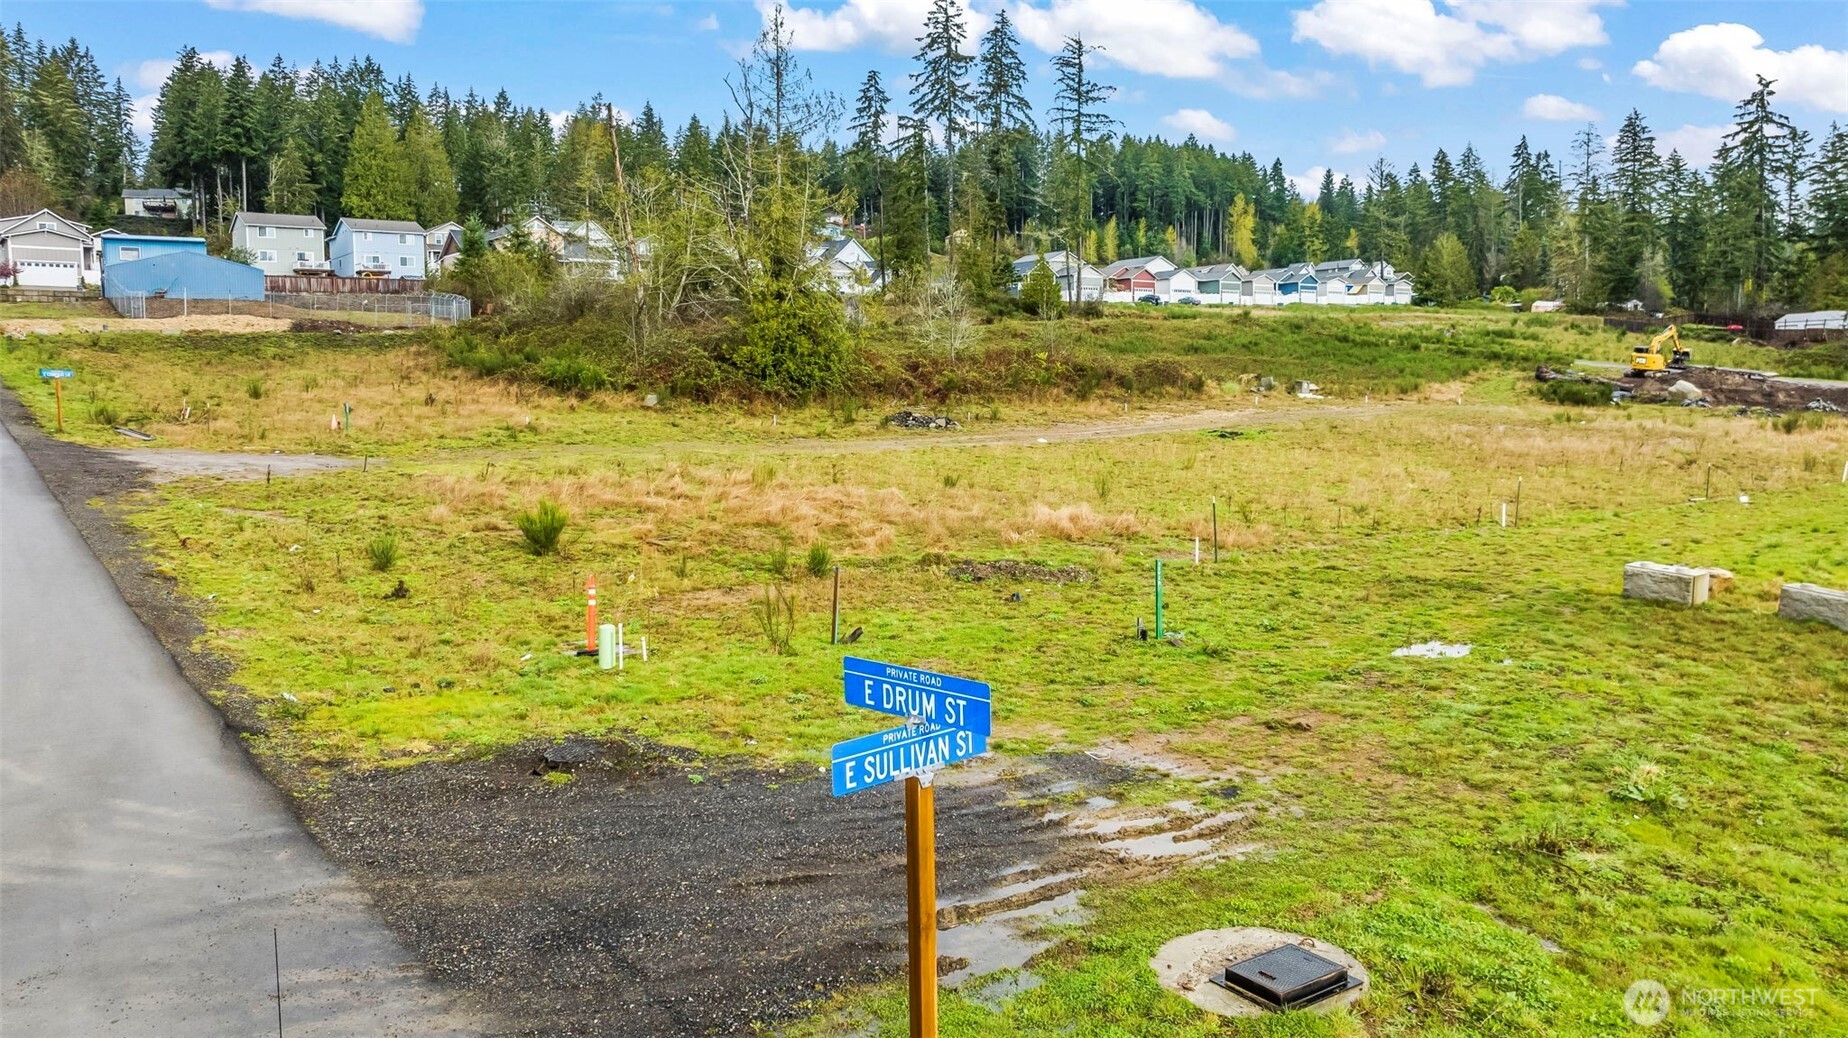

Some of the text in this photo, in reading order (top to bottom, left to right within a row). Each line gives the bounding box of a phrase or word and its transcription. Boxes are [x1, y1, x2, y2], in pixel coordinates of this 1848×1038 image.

[886, 667, 942, 687] PRIVATE ROAD
[864, 680, 967, 726] E DRUM ST
[882, 727, 917, 745] PRIVATE
[845, 761, 857, 789] E
[864, 735, 949, 784] SULLIVAN
